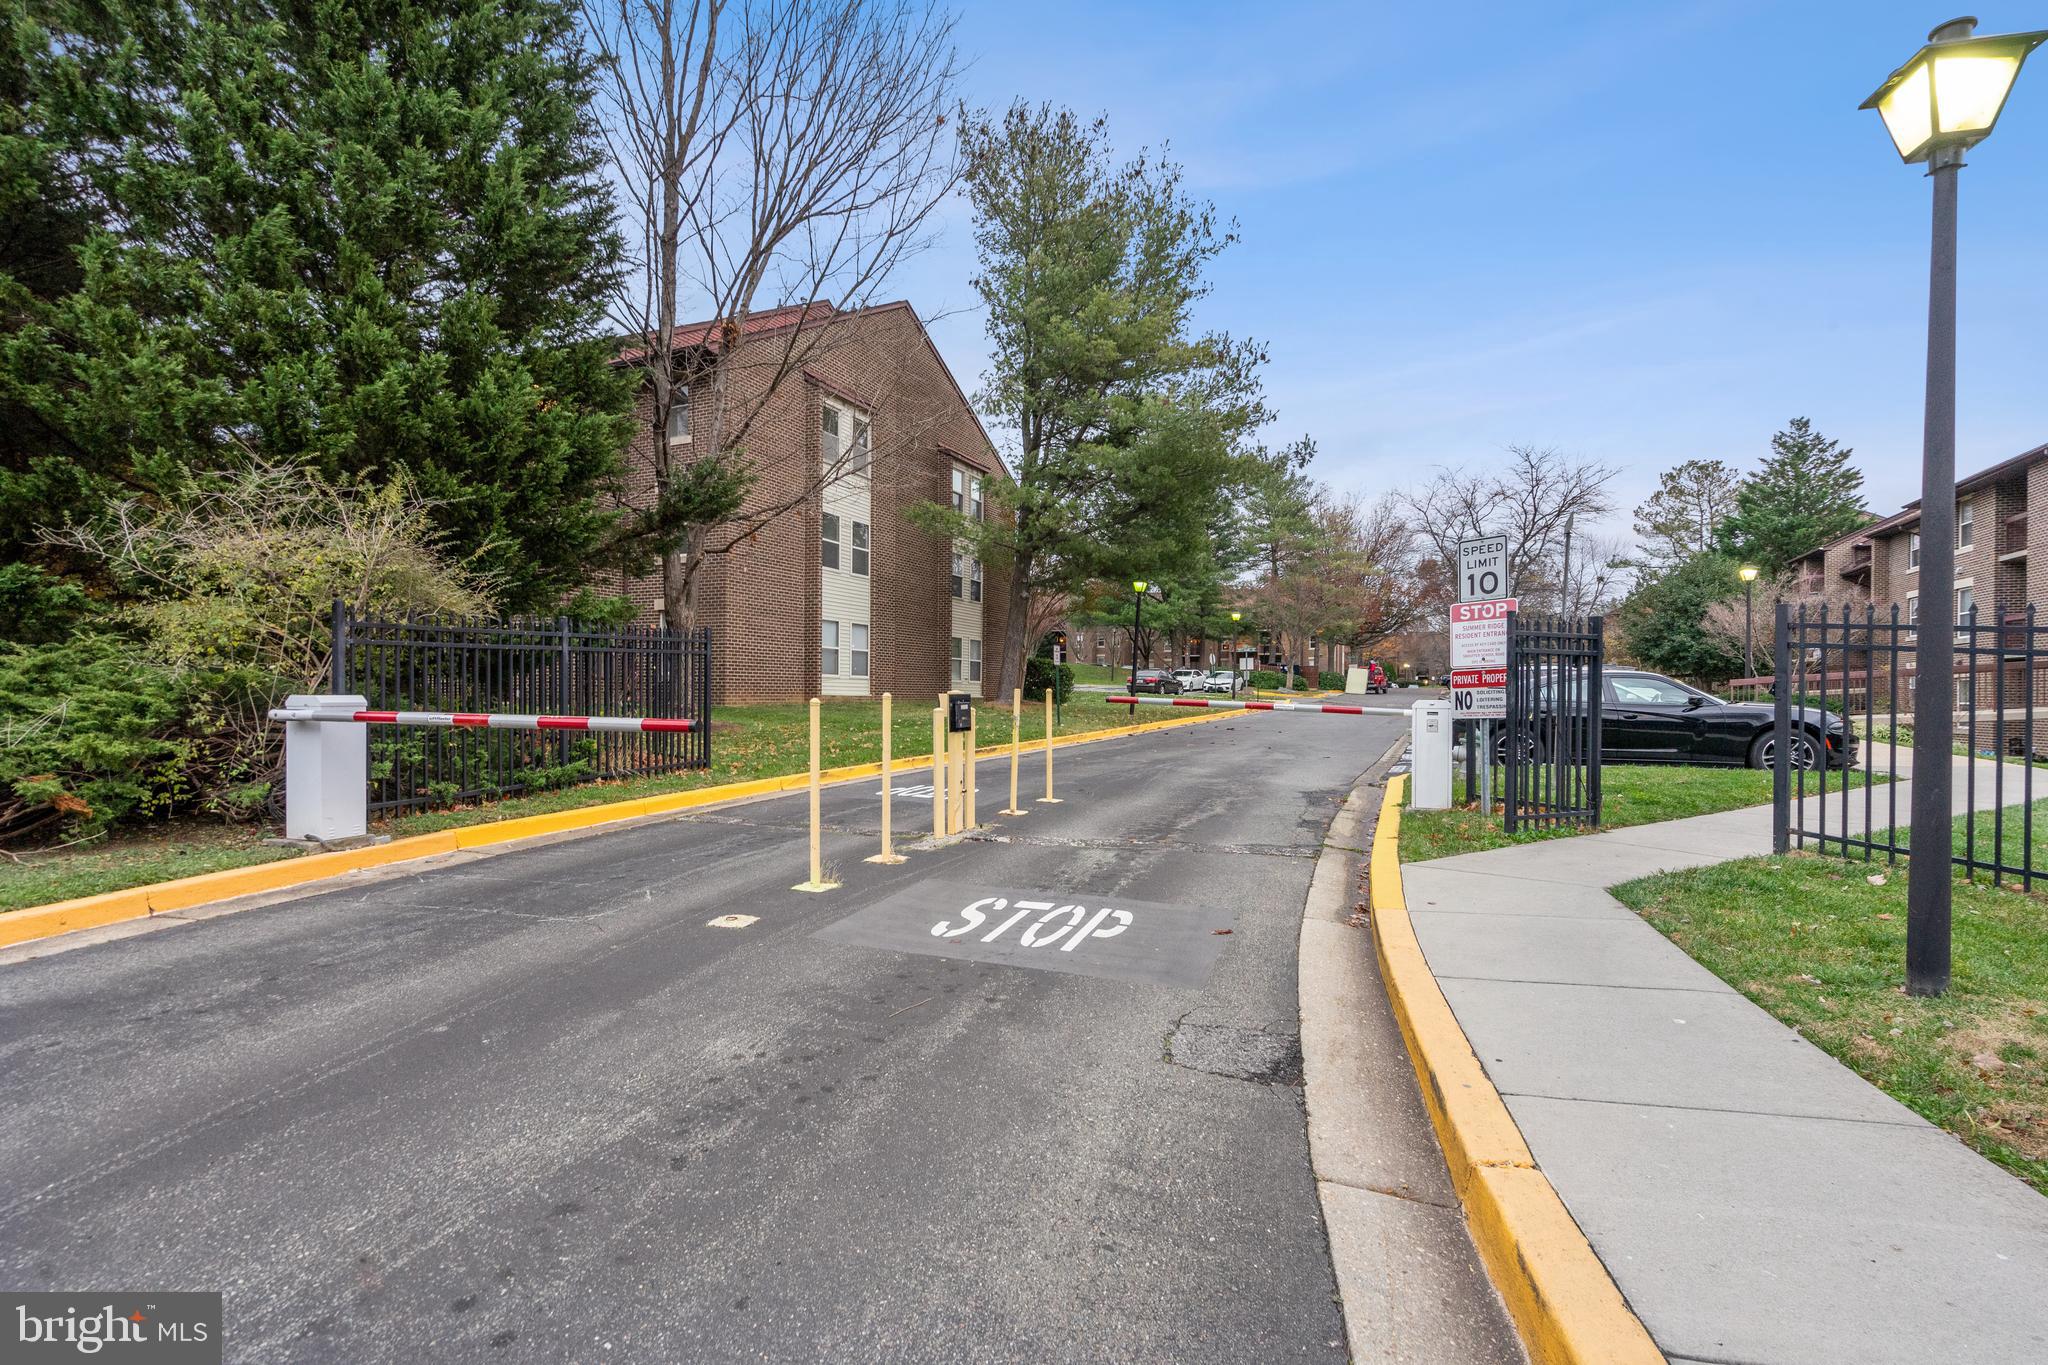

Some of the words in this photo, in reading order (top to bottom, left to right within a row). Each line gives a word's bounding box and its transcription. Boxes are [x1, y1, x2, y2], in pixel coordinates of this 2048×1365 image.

[1463, 543, 1503, 556] SPEED
[1467, 557, 1499, 569] LIMIT
[1467, 571, 1498, 596] 10
[1460, 603, 1507, 620] STOP
[1453, 674, 1479, 685] PRIVATE
[1482, 673, 1507, 683] PROPER
[1455, 690, 1473, 711] NO
[931, 898, 1134, 952] STOP
